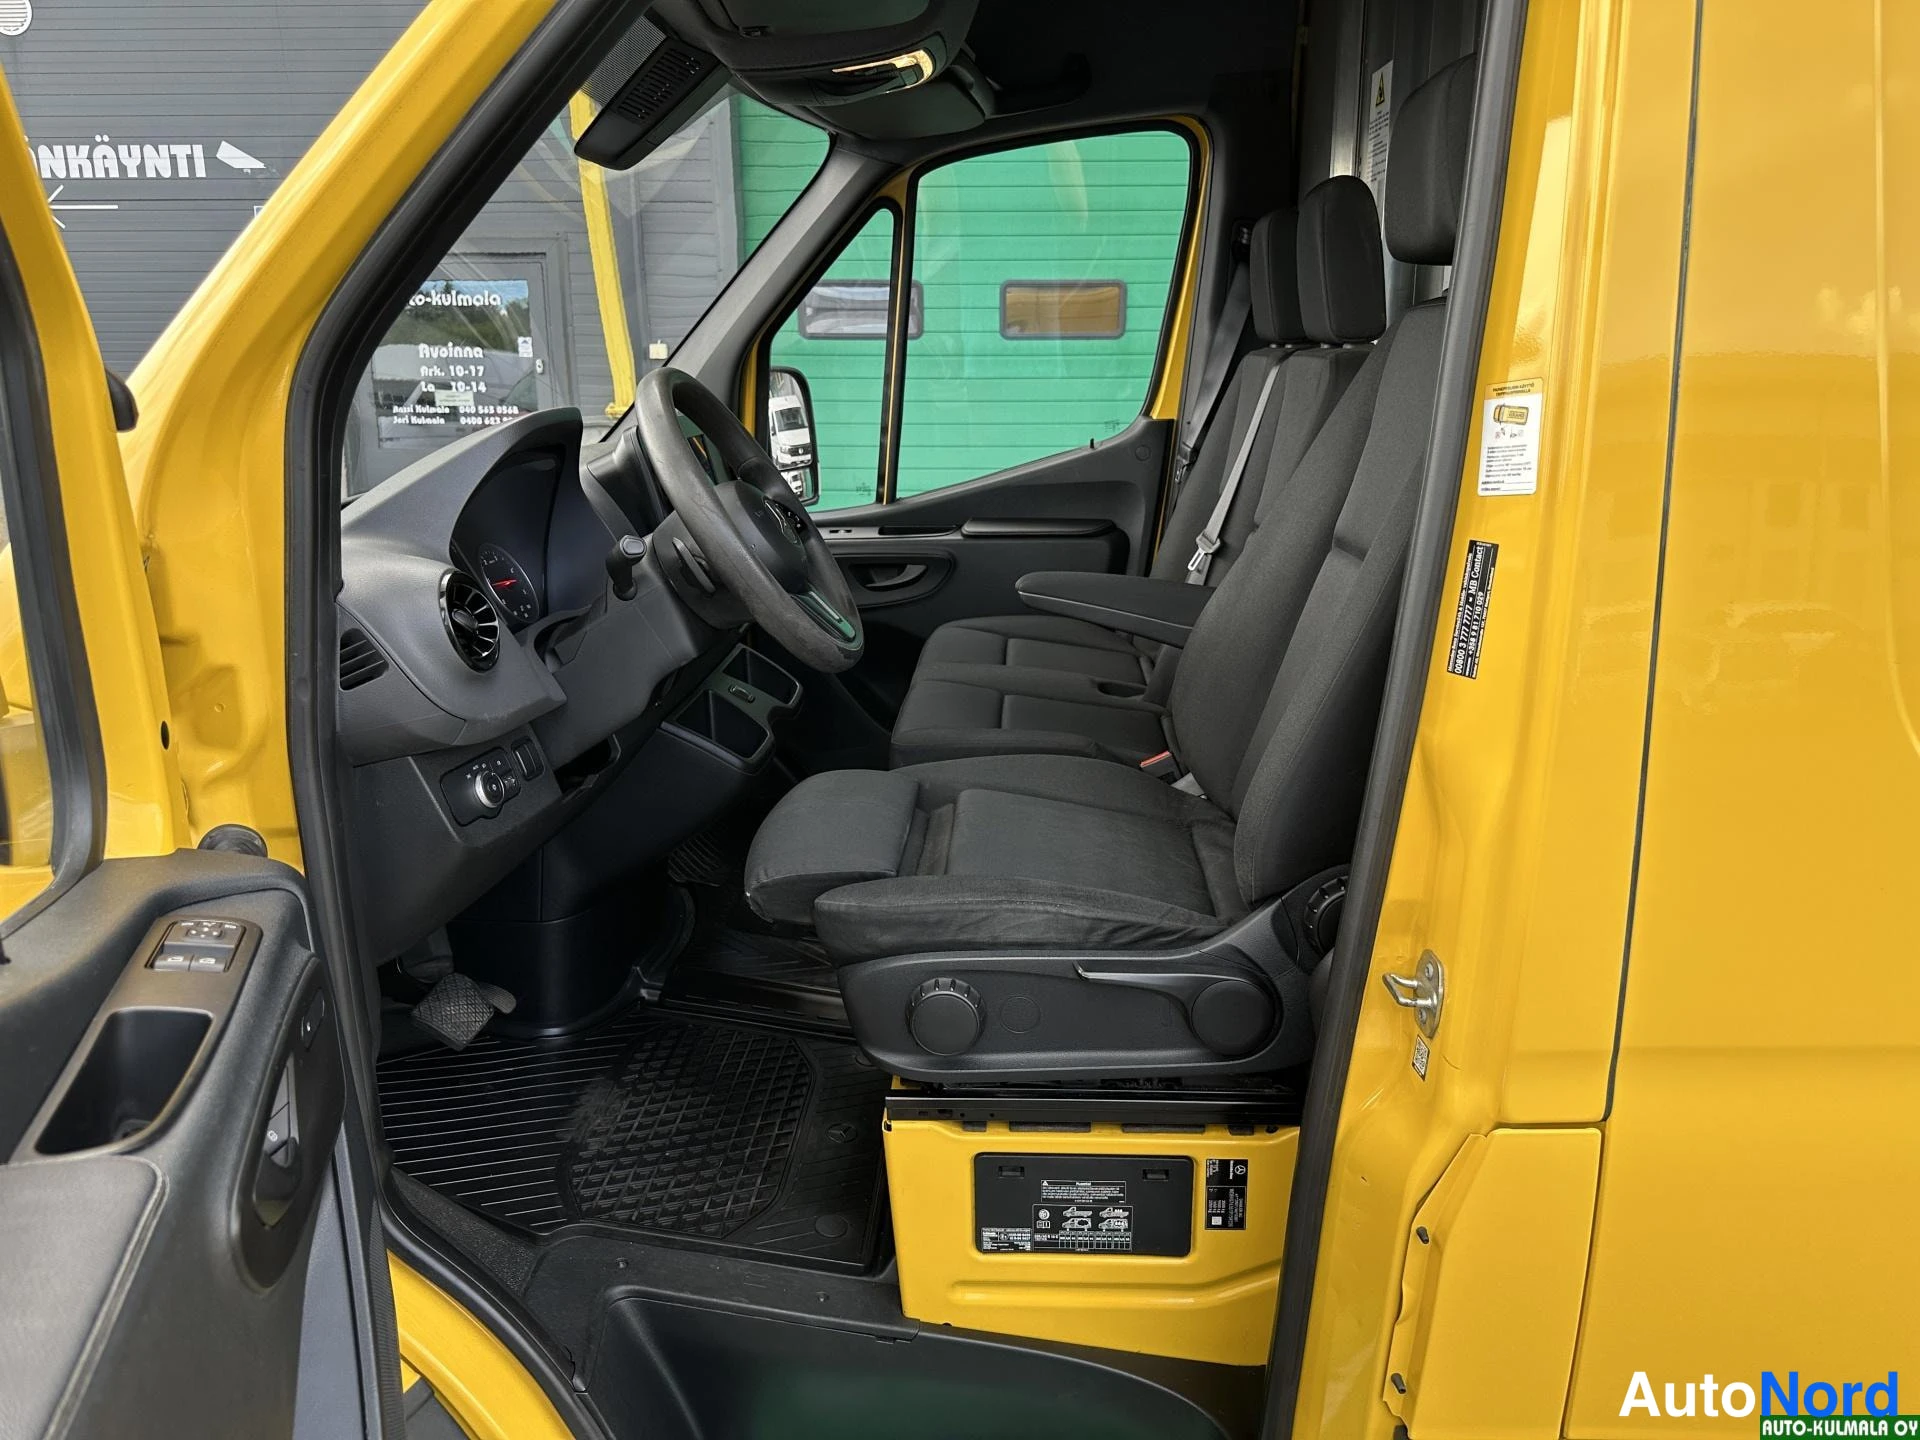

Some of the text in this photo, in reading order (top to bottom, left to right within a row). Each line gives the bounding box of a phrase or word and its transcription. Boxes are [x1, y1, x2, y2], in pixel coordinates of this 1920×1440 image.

[418, 341, 484, 358] Avoinna
[420, 365, 484, 377] Ark. 10-17
[420, 381, 487, 393] La 10-14
[415, 404, 450, 414] Kulmala
[459, 405, 476, 414] 040
[1471, 546, 1484, 578] Contact
[1468, 580, 1478, 595] MB
[1463, 605, 1473, 625] 7777
[1460, 626, 1469, 641] 777
[1454, 649, 1465, 674] 00800
